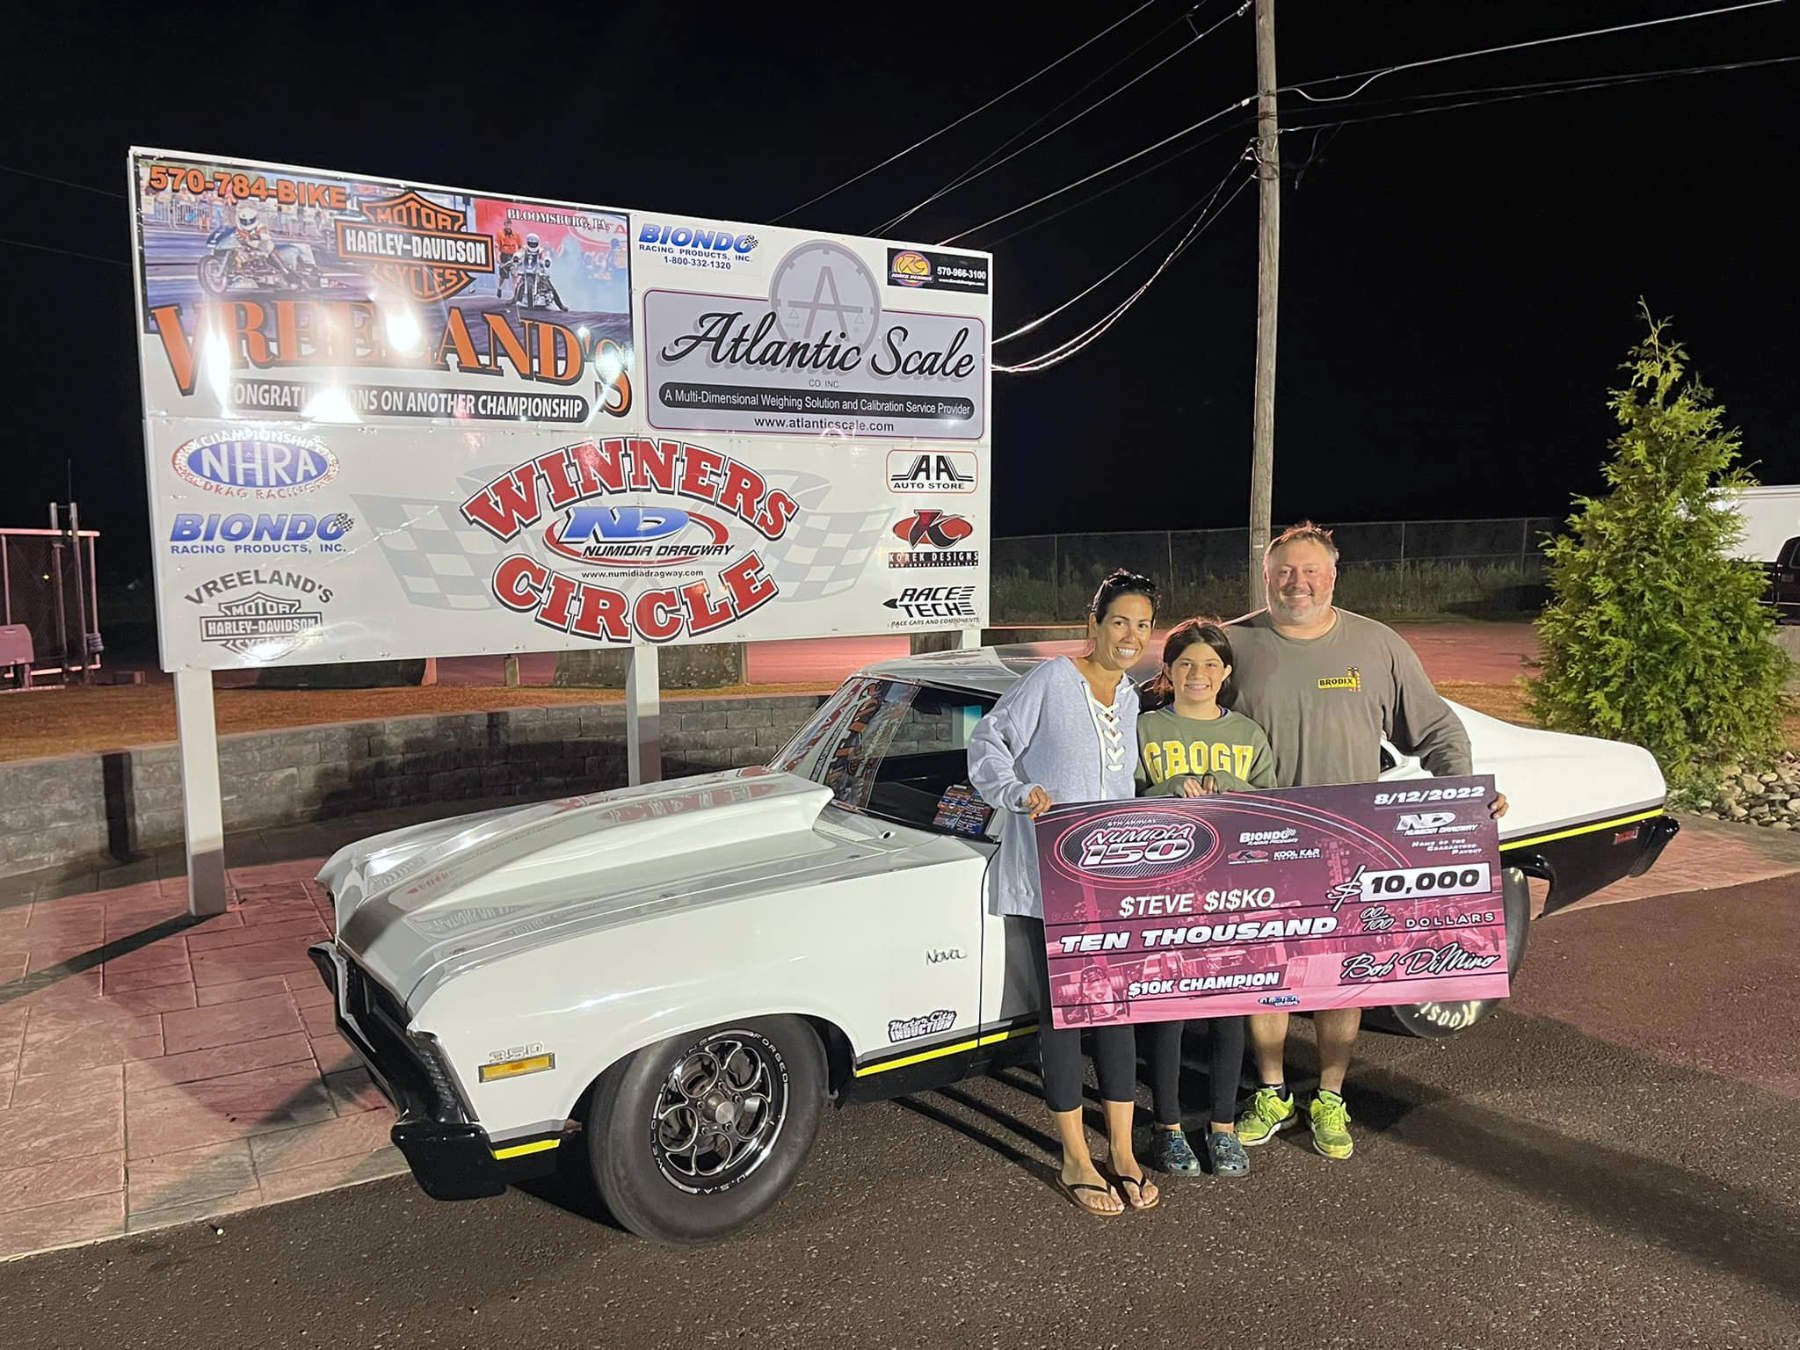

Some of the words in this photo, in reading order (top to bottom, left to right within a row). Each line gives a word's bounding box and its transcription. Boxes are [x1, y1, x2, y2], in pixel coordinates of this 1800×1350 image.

[150, 165, 347, 210] 570-784-BIKE
[376, 201, 452, 231] MOTOR
[346, 229, 486, 265] HARLEY-DAVIDSON
[638, 223, 756, 253] BIONDO
[639, 244, 674, 254] RACING
[679, 249, 730, 261] PRODUCTS,
[663, 256, 731, 270] 1-800-332-1320
[660, 310, 862, 374] Atlantic
[870, 325, 976, 378] Scale
[148, 299, 633, 418] VREEAND'S
[380, 390, 402, 411] ON
[406, 392, 475, 415] ANOTHER
[478, 395, 583, 419] CHAMPIONSHIP
[665, 389, 673, 401] A
[675, 389, 758, 406] Multi-Dimensional
[761, 394, 802, 410] Weighing
[805, 396, 840, 409] Solution
[842, 399, 858, 410] and
[860, 399, 904, 412] Calibration
[906, 401, 936, 414] Service
[938, 402, 971, 415] Provider
[754, 417, 894, 432] www.atlanticscale.com
[200, 441, 318, 487] NHRA
[910, 454, 956, 481] AA
[203, 481, 249, 498] DRAG
[460, 436, 800, 542] WINNERS
[893, 482, 925, 490] AUTO
[928, 482, 965, 490] STORE
[169, 512, 350, 542] BIONDO
[171, 543, 225, 554] RACING
[234, 543, 312, 555] PRODUCTS,
[320, 543, 347, 553] INC.
[582, 545, 653, 557] NUMIDIA
[657, 544, 735, 557] DRAGWAY
[931, 551, 979, 561] DESIGNS
[581, 567, 704, 579] www.numidiadragway.com
[184, 569, 334, 604] VREELAND'S
[492, 550, 779, 643] CIRCLE
[899, 586, 962, 602] RACE
[231, 600, 291, 616] MOTOR
[899, 602, 962, 618] TECH
[207, 618, 317, 636] HARLEY-DAVIDSON
[1319, 678, 1354, 687] BRODIX
[1373, 786, 1486, 806] 8/12/2022
[1085, 826, 1192, 847] NUMIDIA
[1239, 830, 1295, 843] BIONDO
[1081, 839, 1191, 867] 150
[1274, 849, 1297, 858] KOOL
[1299, 848, 1320, 858] KAR
[1326, 864, 1367, 913] $
[1371, 869, 1480, 895] 10,000
[1119, 892, 1194, 918] $TEVE
[1203, 887, 1276, 913] $I$KO
[1405, 912, 1495, 929] DOLLARS
[1060, 931, 1131, 953] TEN
[1141, 916, 1338, 948] THOUSAND
[926, 949, 968, 965] Nova
[1339, 952, 1400, 980] Bob
[1400, 942, 1501, 976] DiMino
[1127, 979, 1174, 998] $10K
[1177, 971, 1280, 993] CHAMPION
[488, 1042, 544, 1063] 350
[752, 1032, 790, 1083] FORGED
